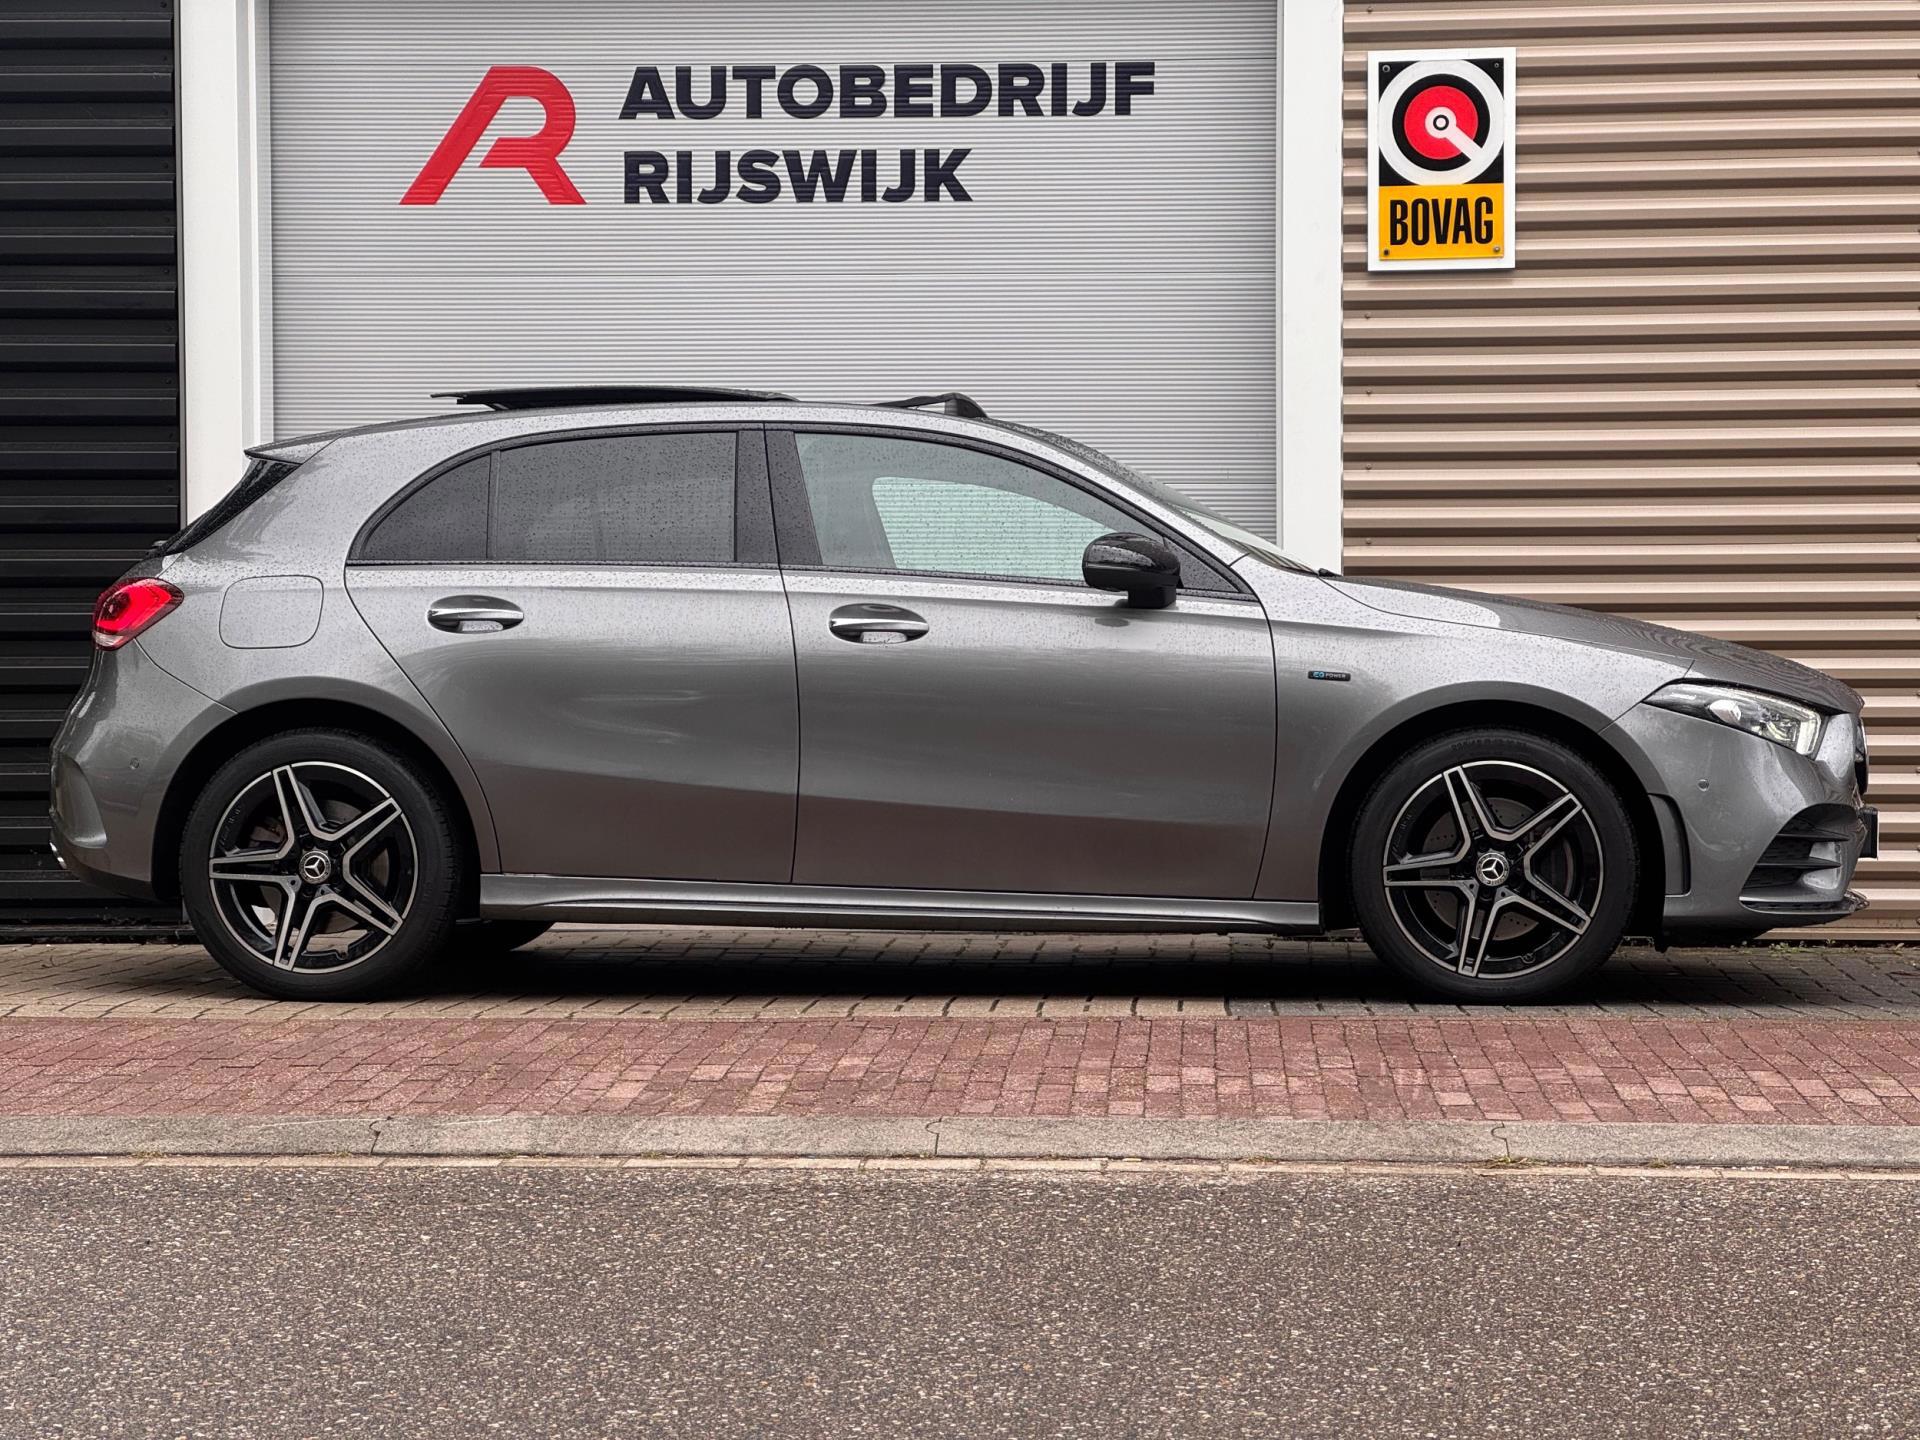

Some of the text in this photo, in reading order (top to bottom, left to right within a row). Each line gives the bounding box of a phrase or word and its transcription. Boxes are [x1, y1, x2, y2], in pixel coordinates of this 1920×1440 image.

[618, 61, 1156, 120] AUTOBEDRIJF
[624, 148, 973, 205] RIJSWIJK
[1389, 196, 1494, 246] BOVAG
